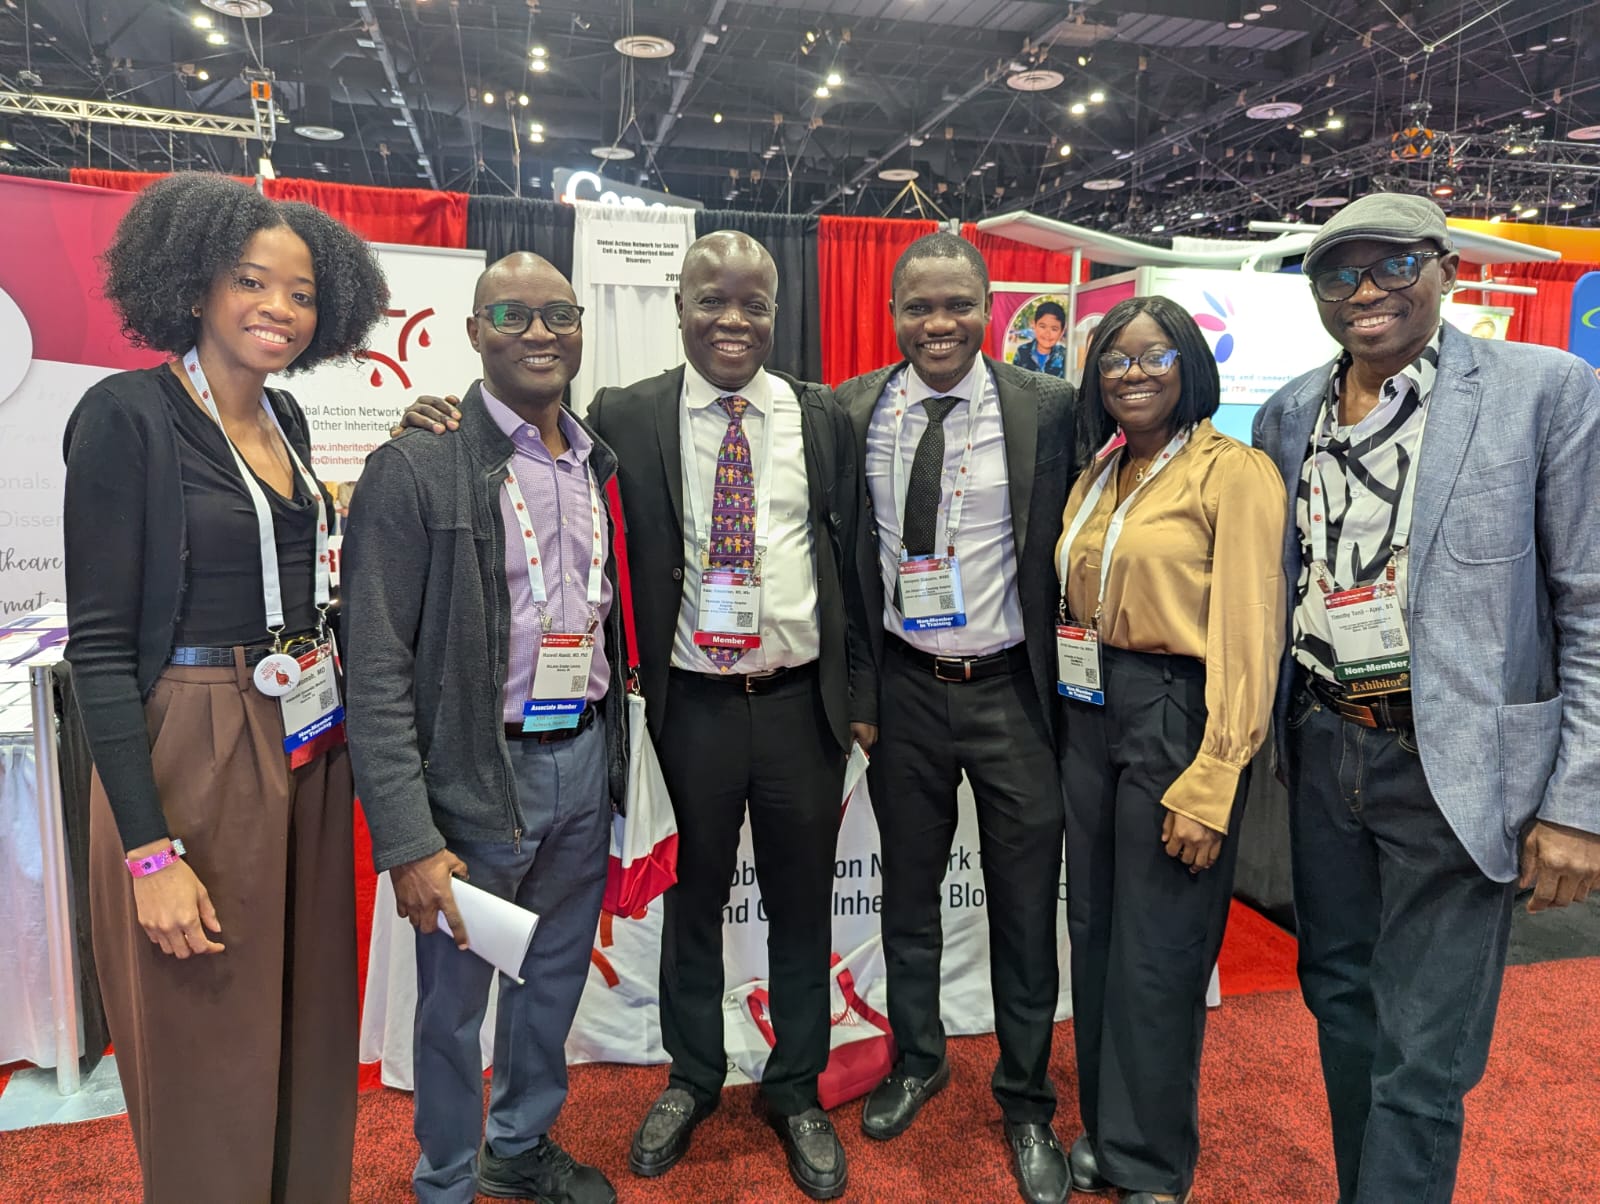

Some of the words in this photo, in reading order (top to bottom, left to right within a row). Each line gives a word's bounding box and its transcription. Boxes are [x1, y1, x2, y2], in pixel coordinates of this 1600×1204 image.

[597, 239, 614, 247] Global
[323, 405, 356, 416] Action
[359, 406, 402, 417] Network
[312, 420, 342, 431] Other
[345, 421, 390, 431] Inherited
[916, 617, 954, 625] Non-Member
[1331, 611, 1350, 621] Timothy
[712, 636, 746, 645] Member
[1344, 659, 1408, 676] Non-Member
[1351, 678, 1402, 692] Exhibitor
[298, 715, 334, 739] Non-Member
